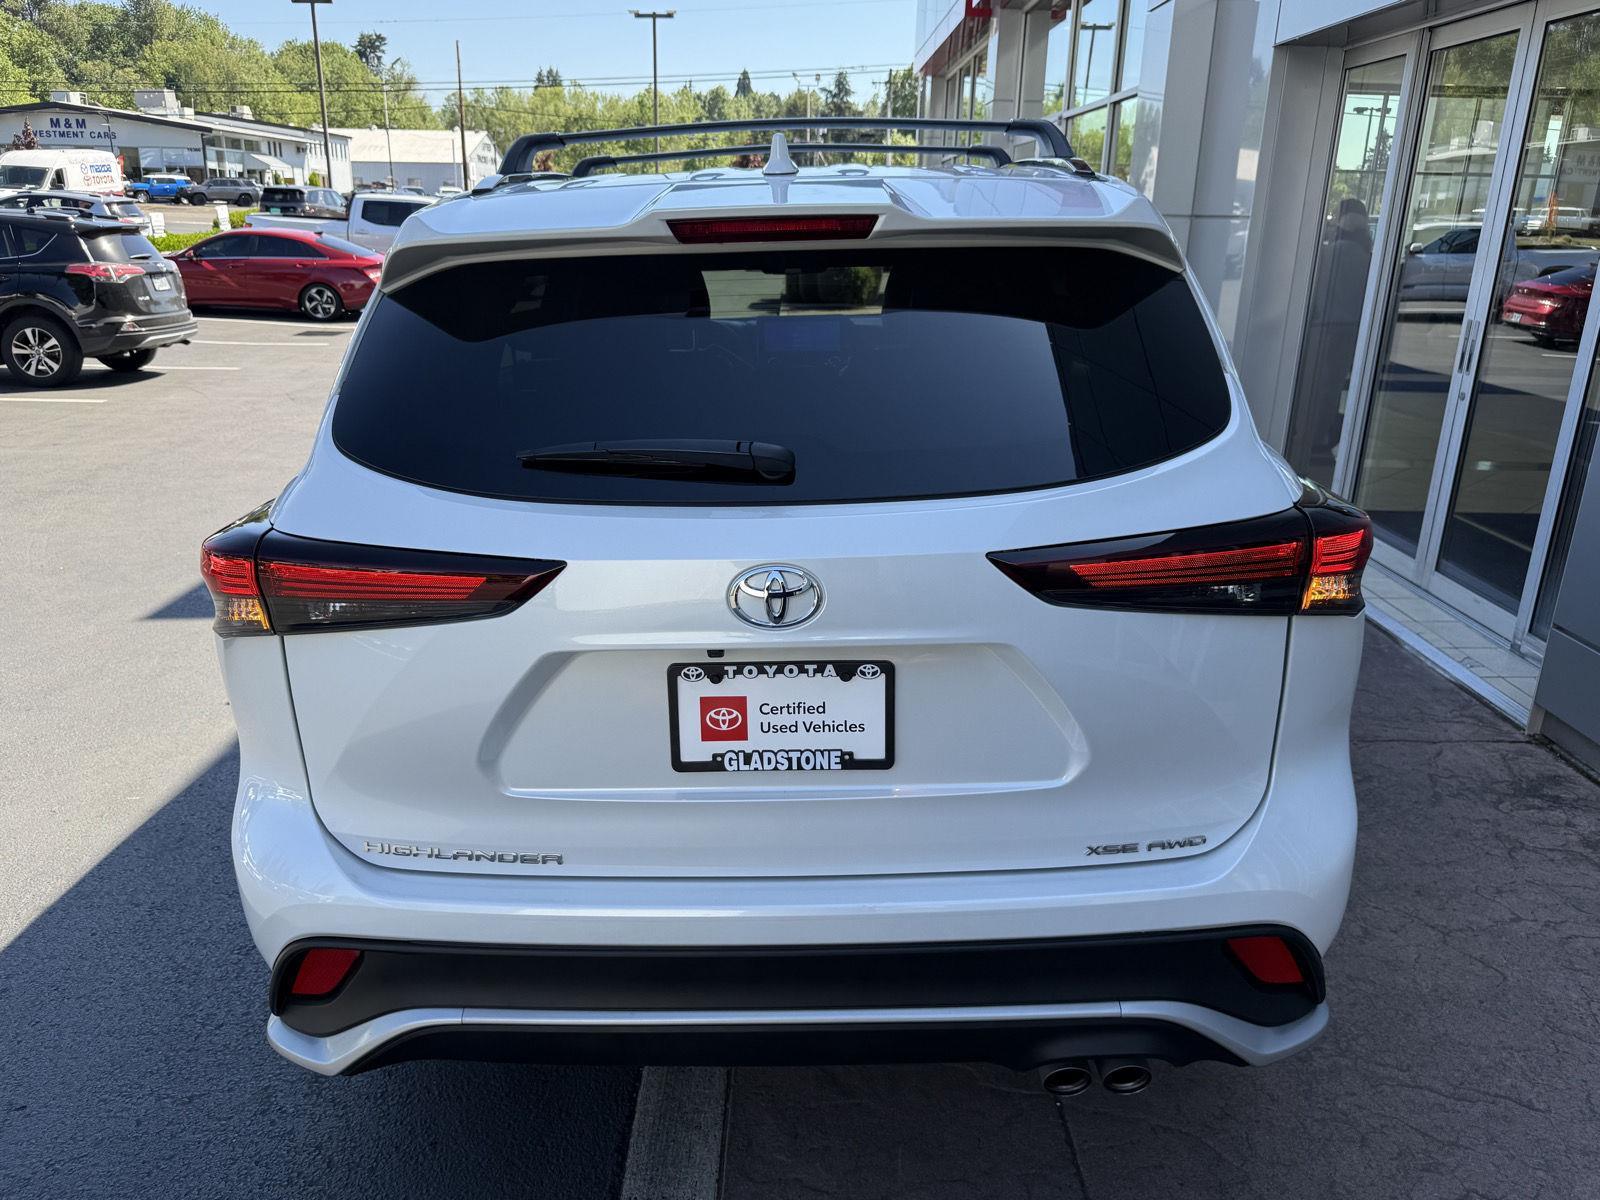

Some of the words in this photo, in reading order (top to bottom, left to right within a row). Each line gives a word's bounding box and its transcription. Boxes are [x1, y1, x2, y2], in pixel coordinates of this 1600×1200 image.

[50, 118, 60, 128] M
[64, 118, 72, 128] &
[76, 118, 86, 129] M
[31, 130, 84, 138] VESTMENT
[90, 131, 116, 139] CARS
[92, 176, 114, 184] TOYOTA
[724, 664, 838, 680] TOYOTA
[759, 702, 826, 716] Certified
[760, 721, 798, 734] Used
[802, 720, 866, 734] Vehicles
[724, 750, 842, 771] GLADSTONE
[364, 840, 564, 865] HIGHLANDER
[1085, 843, 1139, 856] XSE
[1146, 835, 1207, 852] AWD
